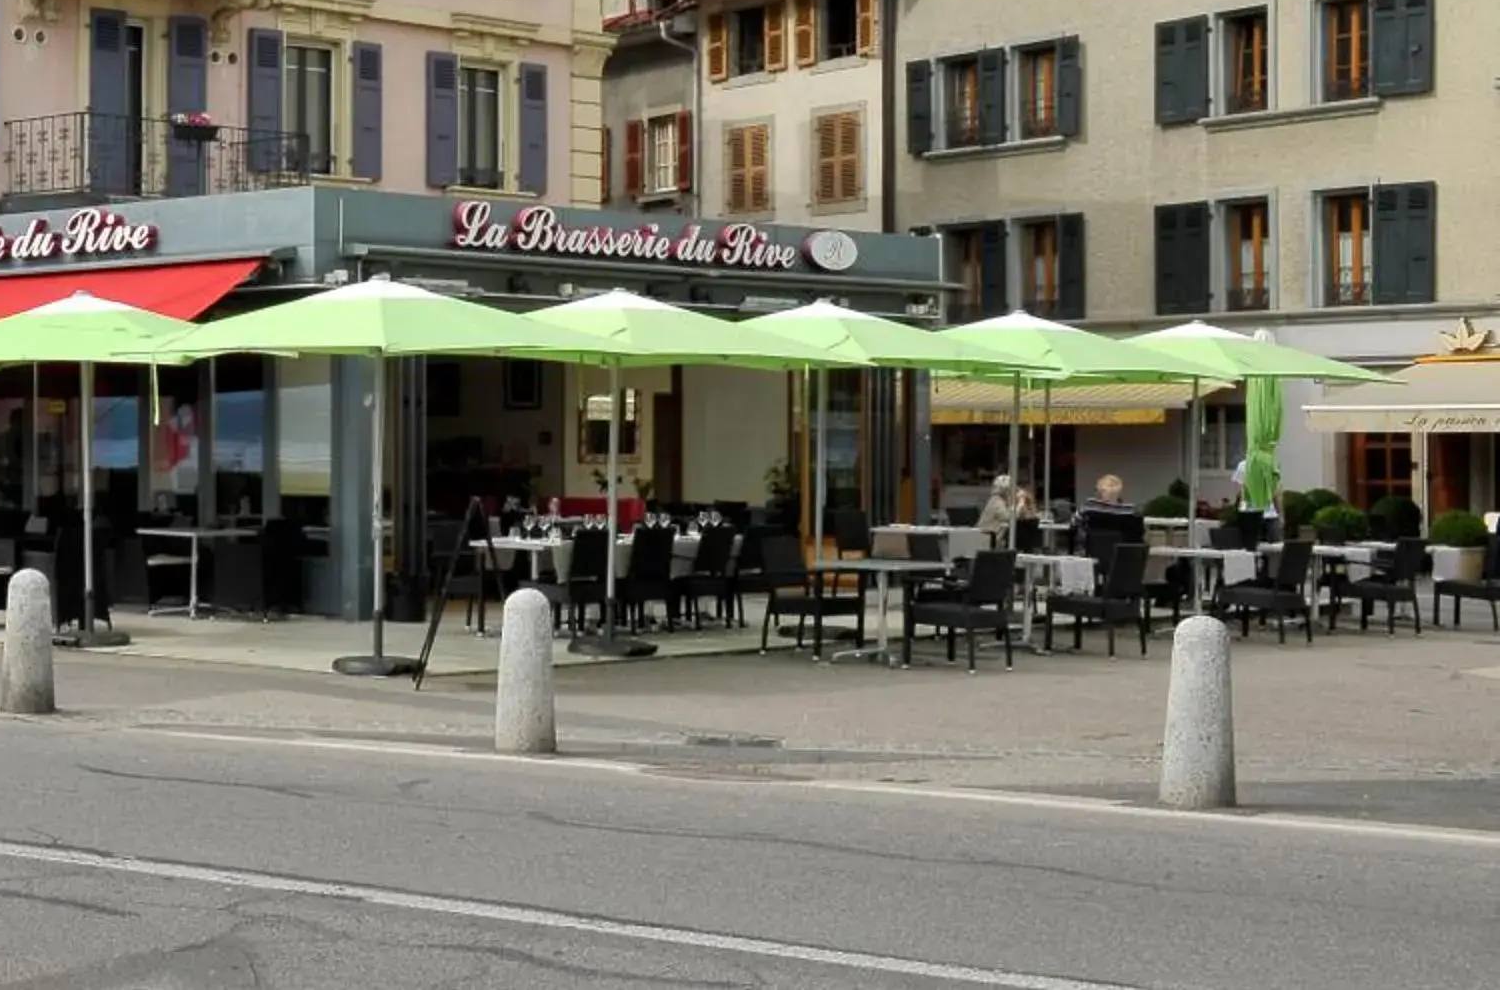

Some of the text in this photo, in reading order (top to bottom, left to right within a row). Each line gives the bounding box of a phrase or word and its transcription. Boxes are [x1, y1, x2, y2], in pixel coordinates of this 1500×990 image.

[12, 219, 55, 259] du
[62, 209, 150, 254] Rive
[457, 201, 795, 268] La Brasserie du Rive
